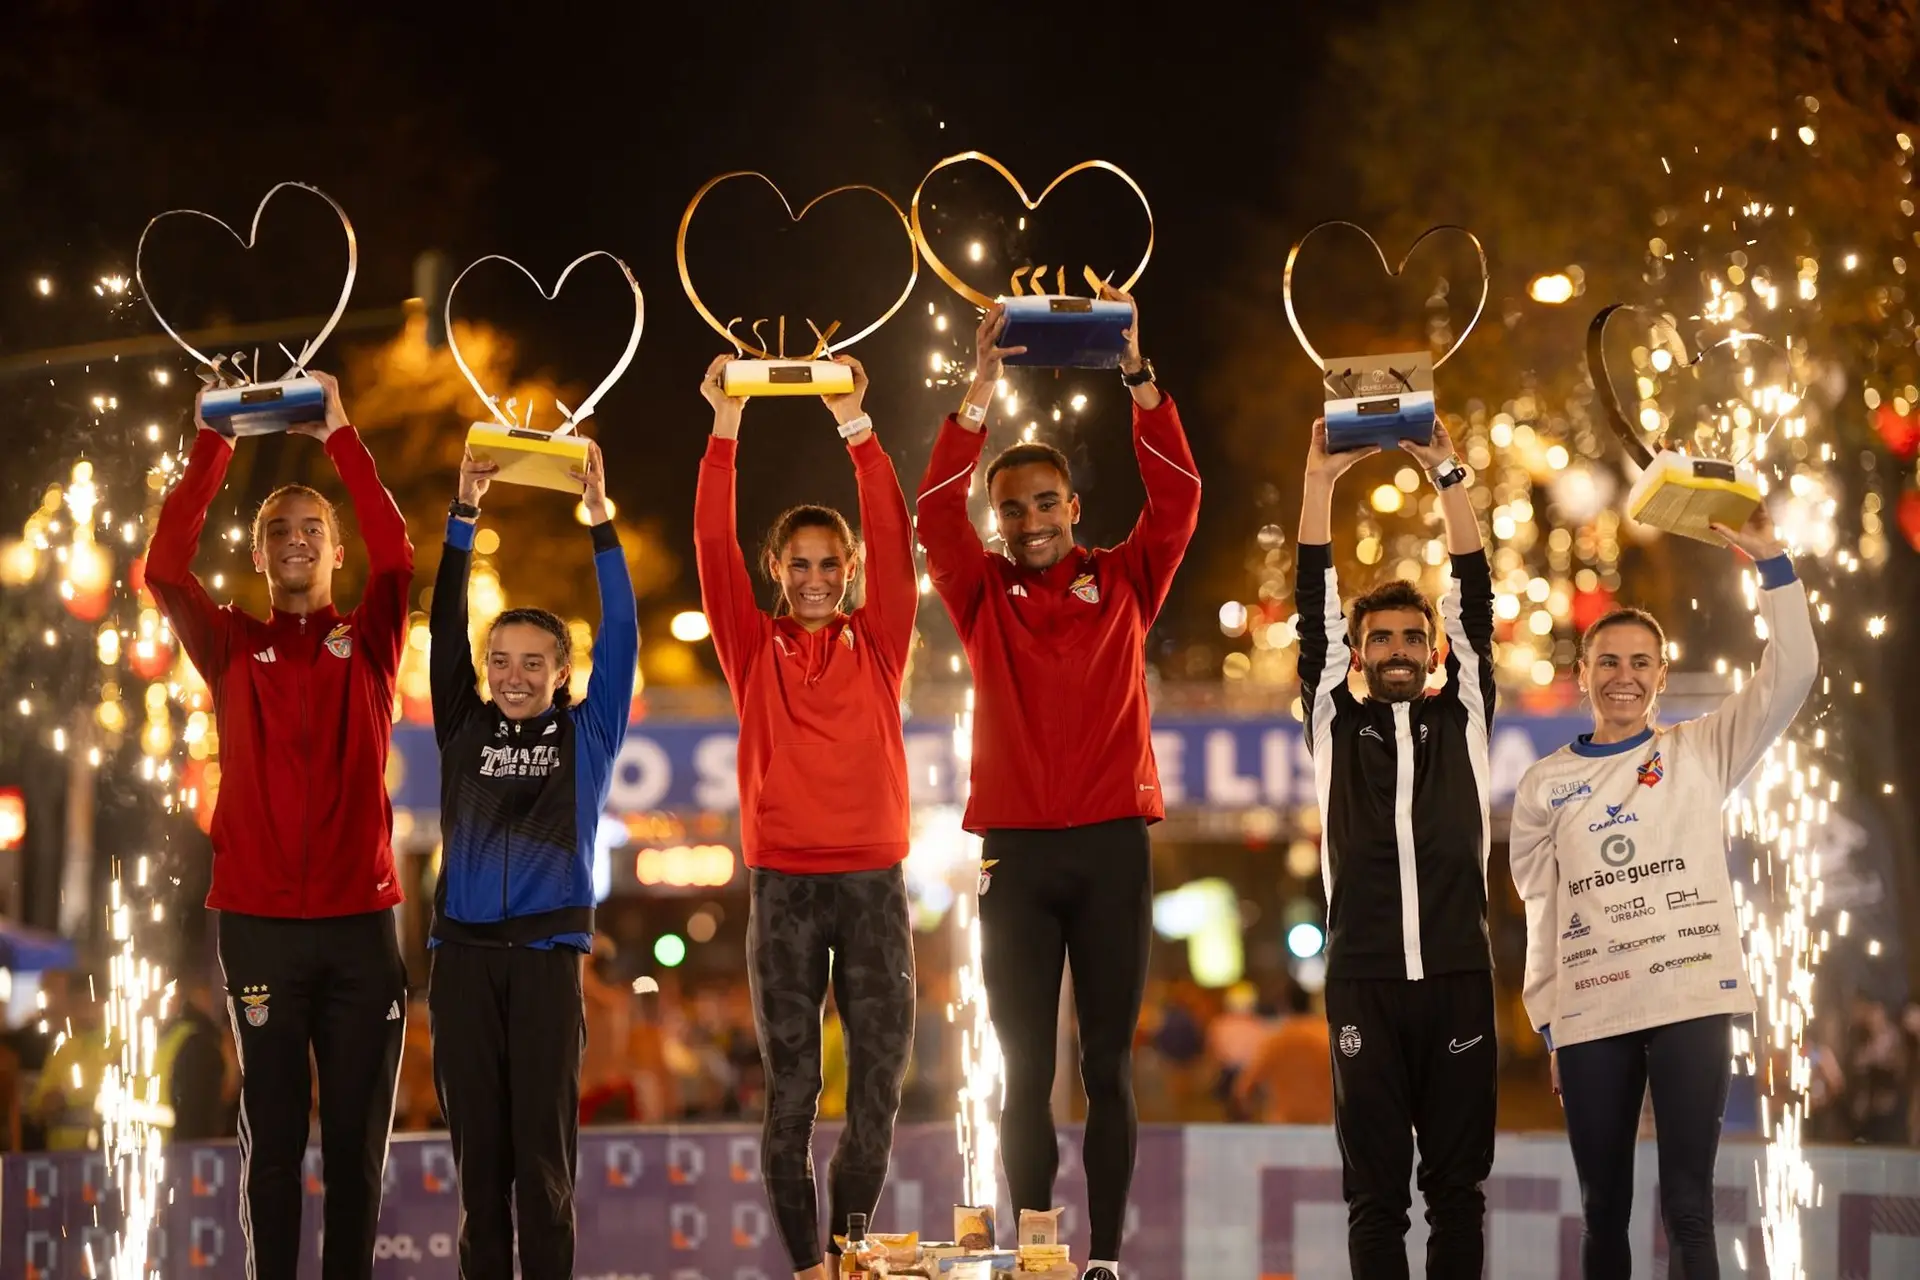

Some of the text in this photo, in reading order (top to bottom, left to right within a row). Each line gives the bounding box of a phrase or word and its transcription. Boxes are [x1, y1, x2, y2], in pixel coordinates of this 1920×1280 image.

[1666, 888, 1699, 910] PH
[1611, 906, 1656, 923] URBANO
[1678, 923, 1720, 938] ITALBOX
[1575, 970, 1631, 991] BESTLOQUE
